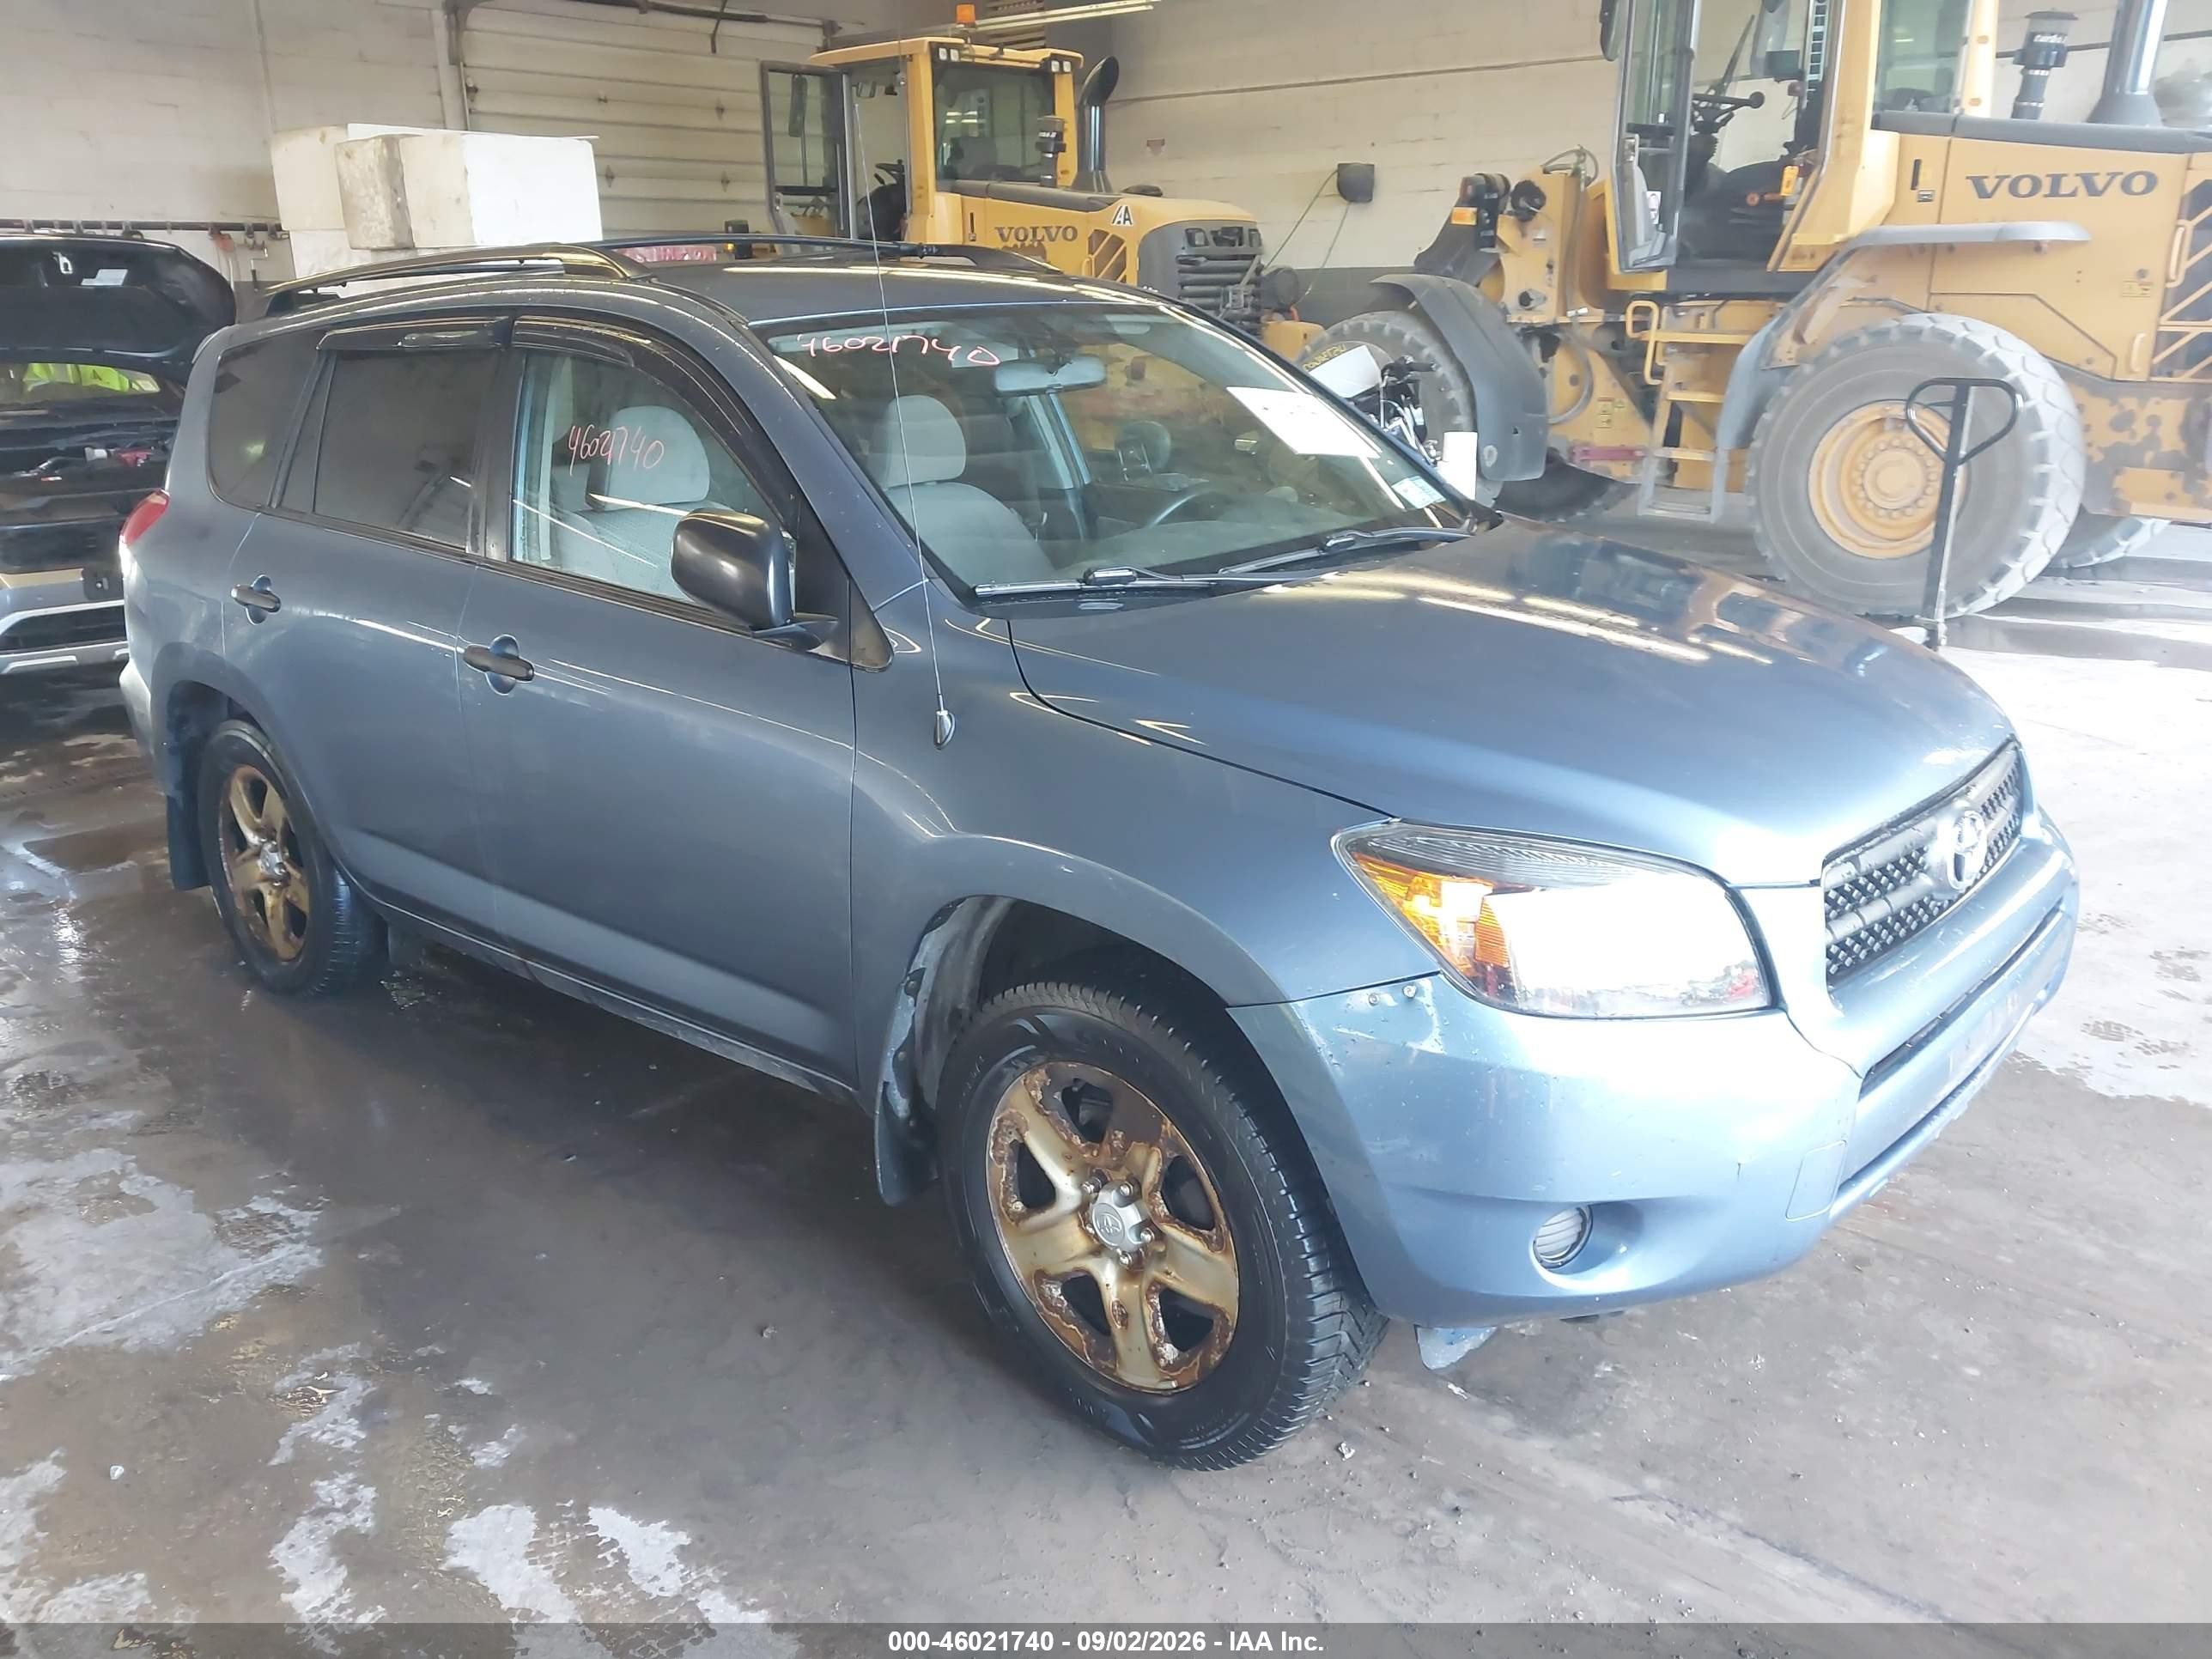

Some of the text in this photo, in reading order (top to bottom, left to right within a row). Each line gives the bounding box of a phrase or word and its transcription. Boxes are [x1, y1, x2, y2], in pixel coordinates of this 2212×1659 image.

[1966, 170, 2159, 199] VOLVO
[994, 225, 1079, 243] VOLVO
[797, 333, 1001, 367] 46021740
[568, 423, 665, 477] 46021740
